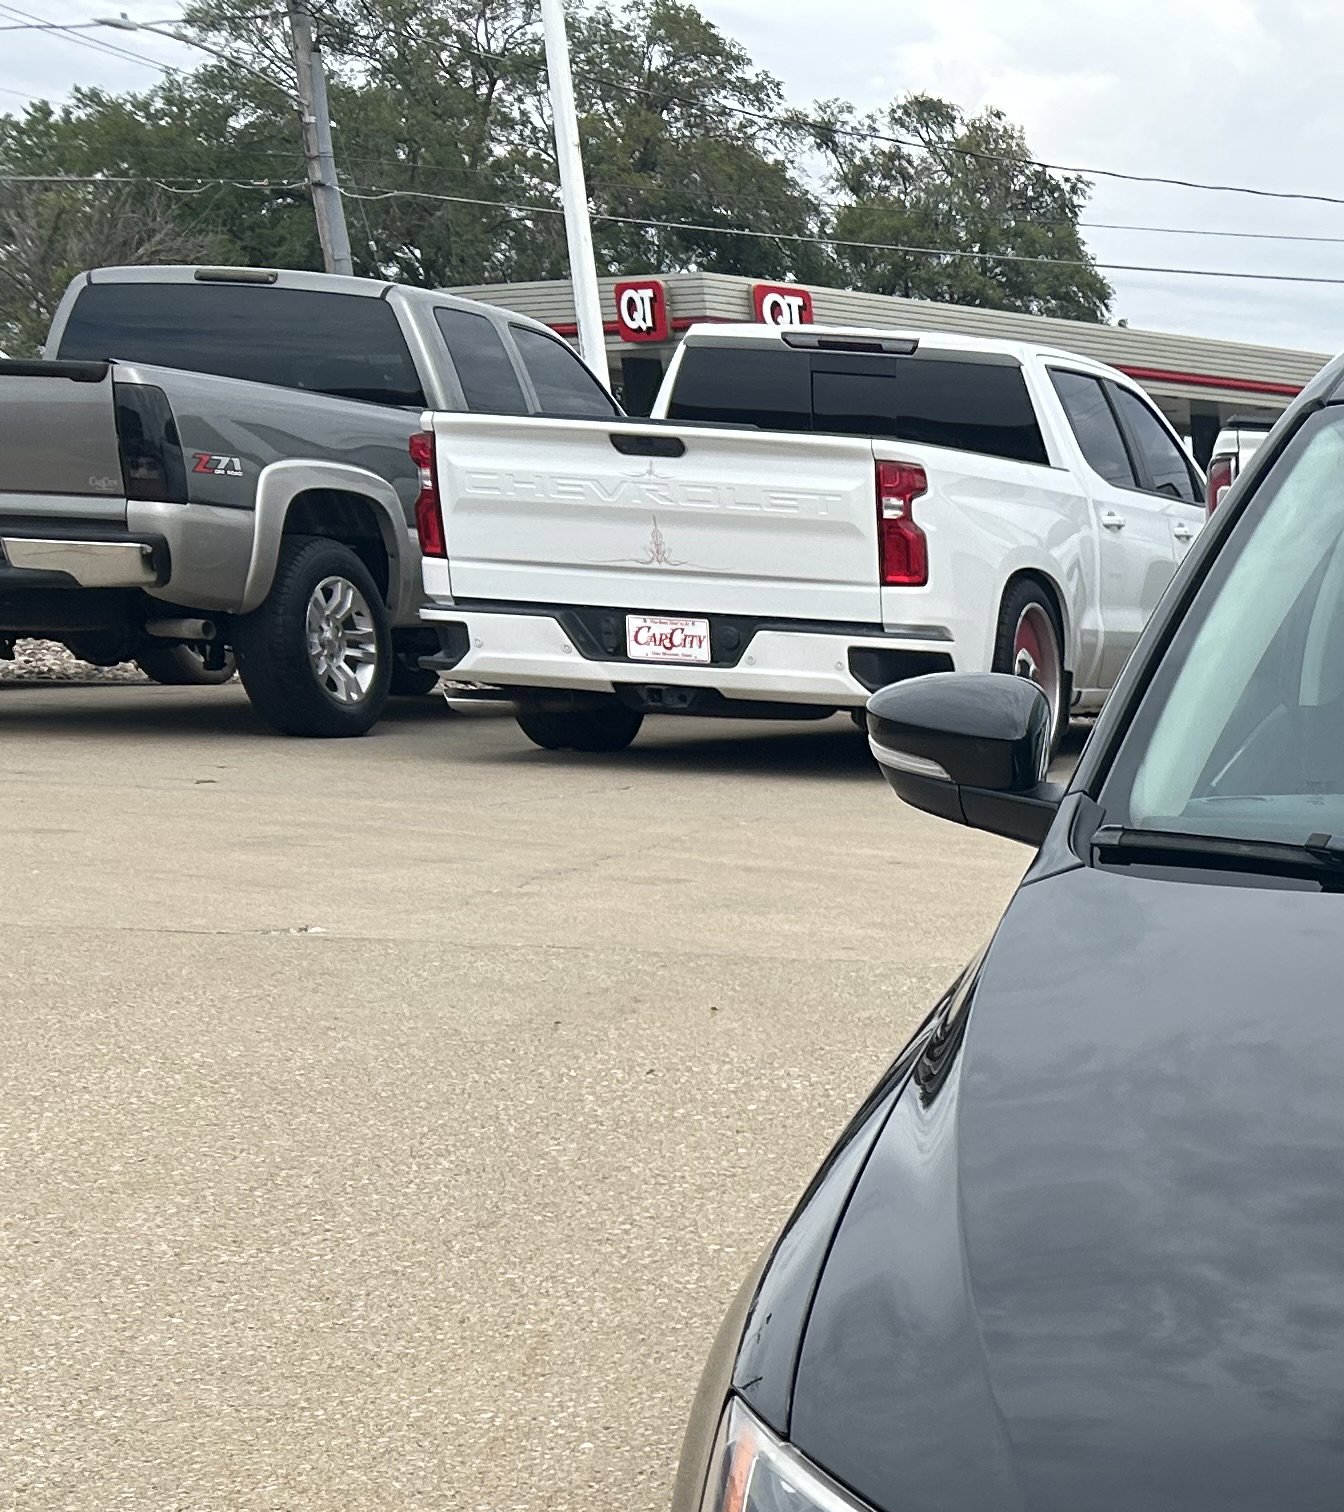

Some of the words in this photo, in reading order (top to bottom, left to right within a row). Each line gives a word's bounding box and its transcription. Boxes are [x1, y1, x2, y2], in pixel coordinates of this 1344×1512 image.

[620, 288, 654, 331] QT
[762, 292, 804, 326] QT
[192, 452, 242, 474] Z71
[464, 470, 843, 515] CHEVROLET
